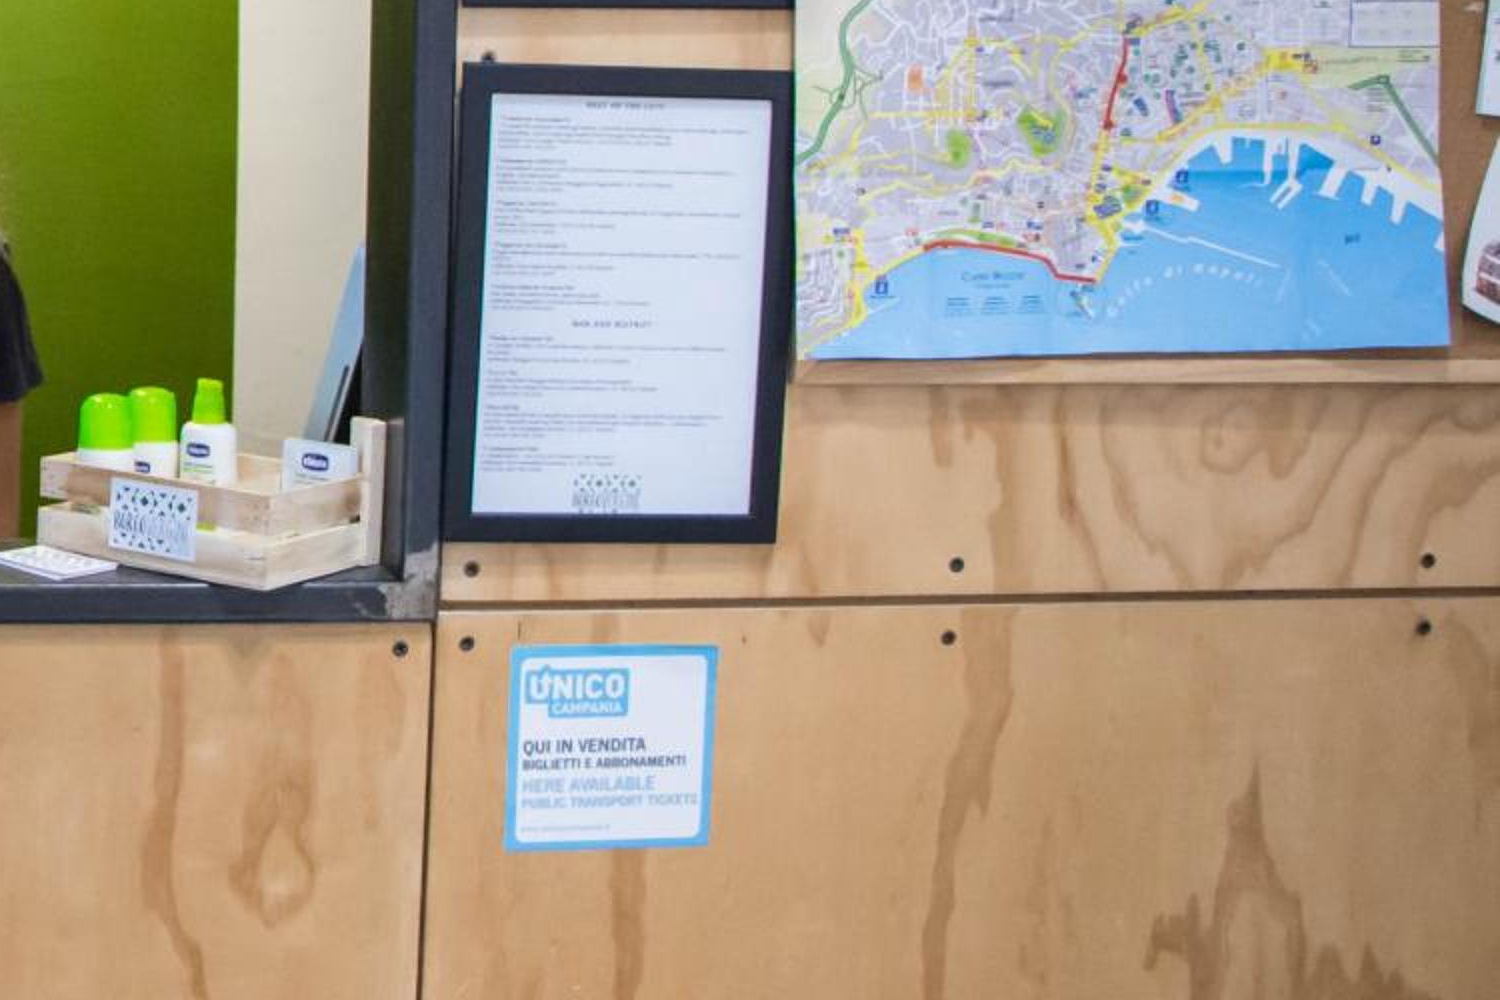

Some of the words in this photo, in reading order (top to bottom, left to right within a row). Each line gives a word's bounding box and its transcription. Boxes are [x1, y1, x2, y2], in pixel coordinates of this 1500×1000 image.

[522, 740, 552, 756] QUI
[556, 739, 573, 753] IN
[578, 737, 647, 753] VENDITA
[522, 758, 581, 771] BIGLIETTI
[585, 758, 591, 769] E
[596, 755, 687, 769] ABBONAMENTI
[522, 778, 565, 793] HERE
[570, 776, 657, 793] AVAILABLE
[522, 795, 569, 810] PUBLIC
[571, 793, 643, 809] TRANSPORT
[649, 792, 698, 806] TICKETS
